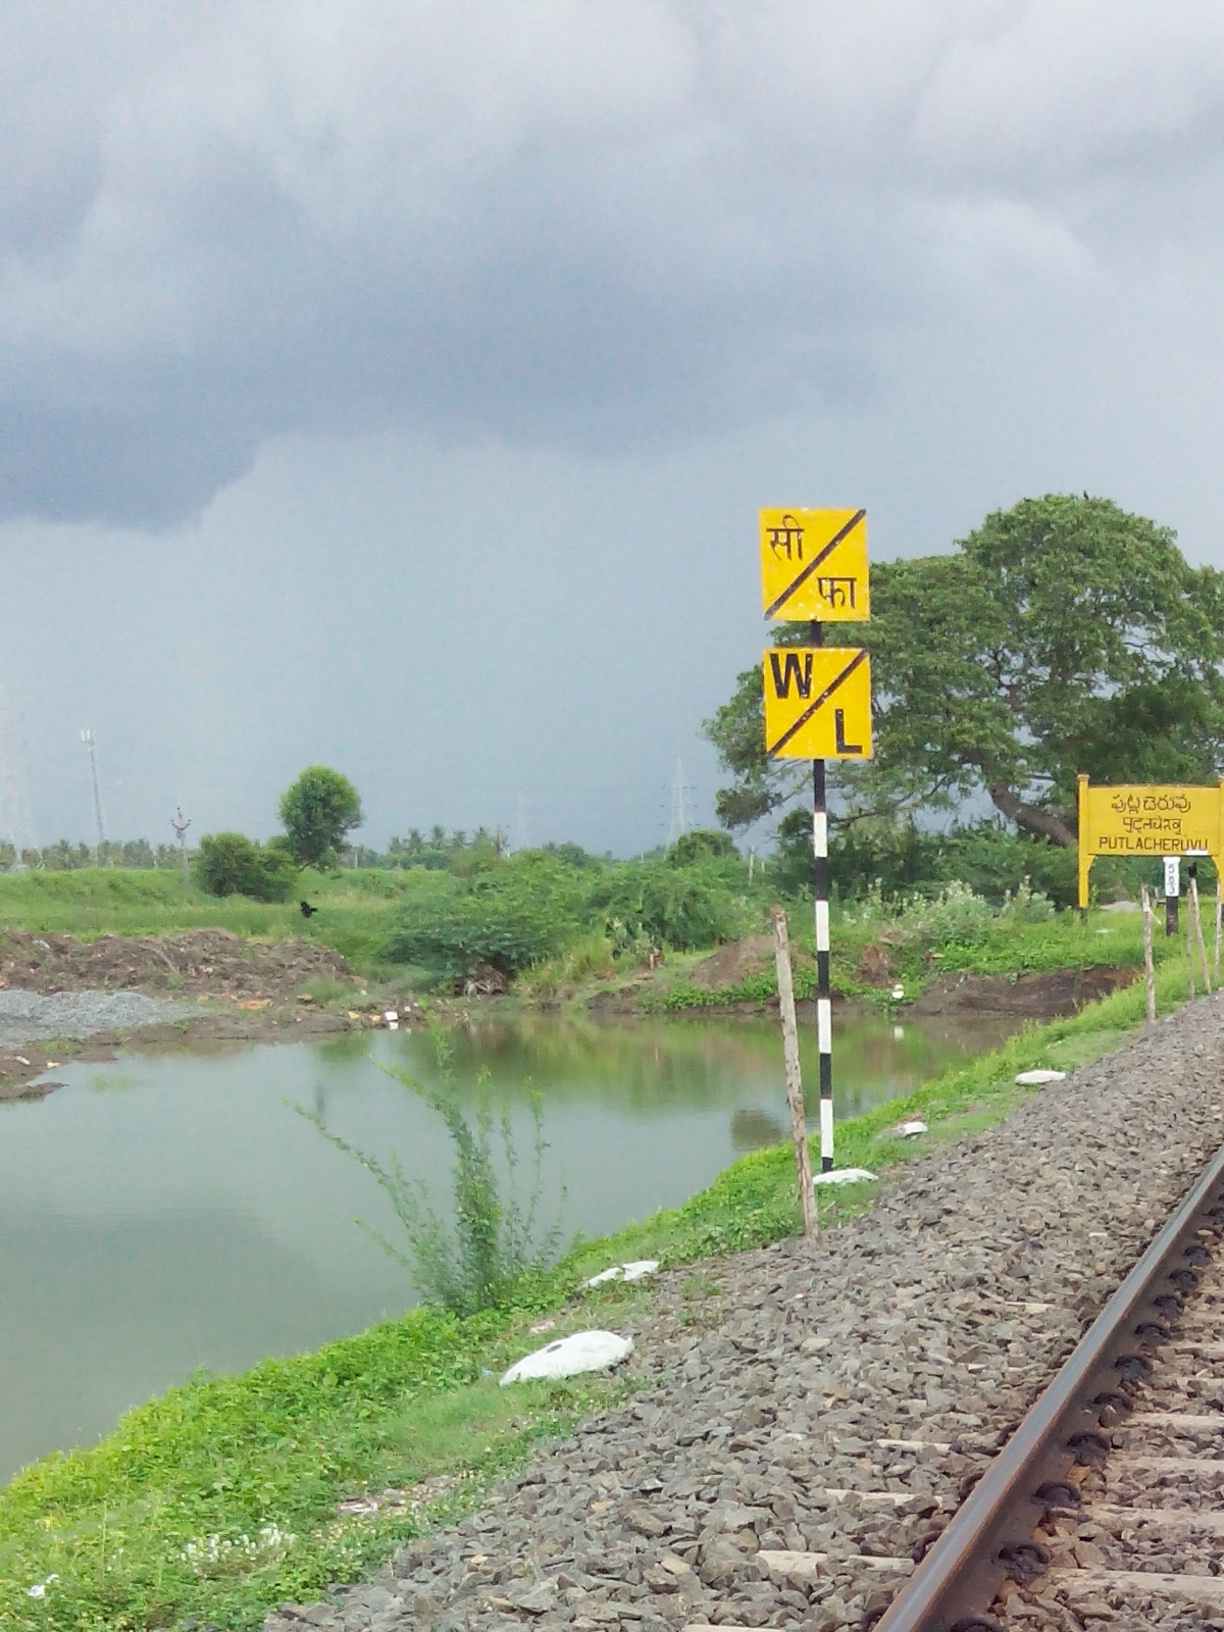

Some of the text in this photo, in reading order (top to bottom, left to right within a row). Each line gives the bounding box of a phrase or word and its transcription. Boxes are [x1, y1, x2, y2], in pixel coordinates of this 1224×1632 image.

[766, 514, 804, 562] सी
[817, 577, 857, 609] फा
[769, 653, 813, 699] W
[834, 708, 863, 754] L
[1099, 836, 1208, 852] PUTLACHERUVU
